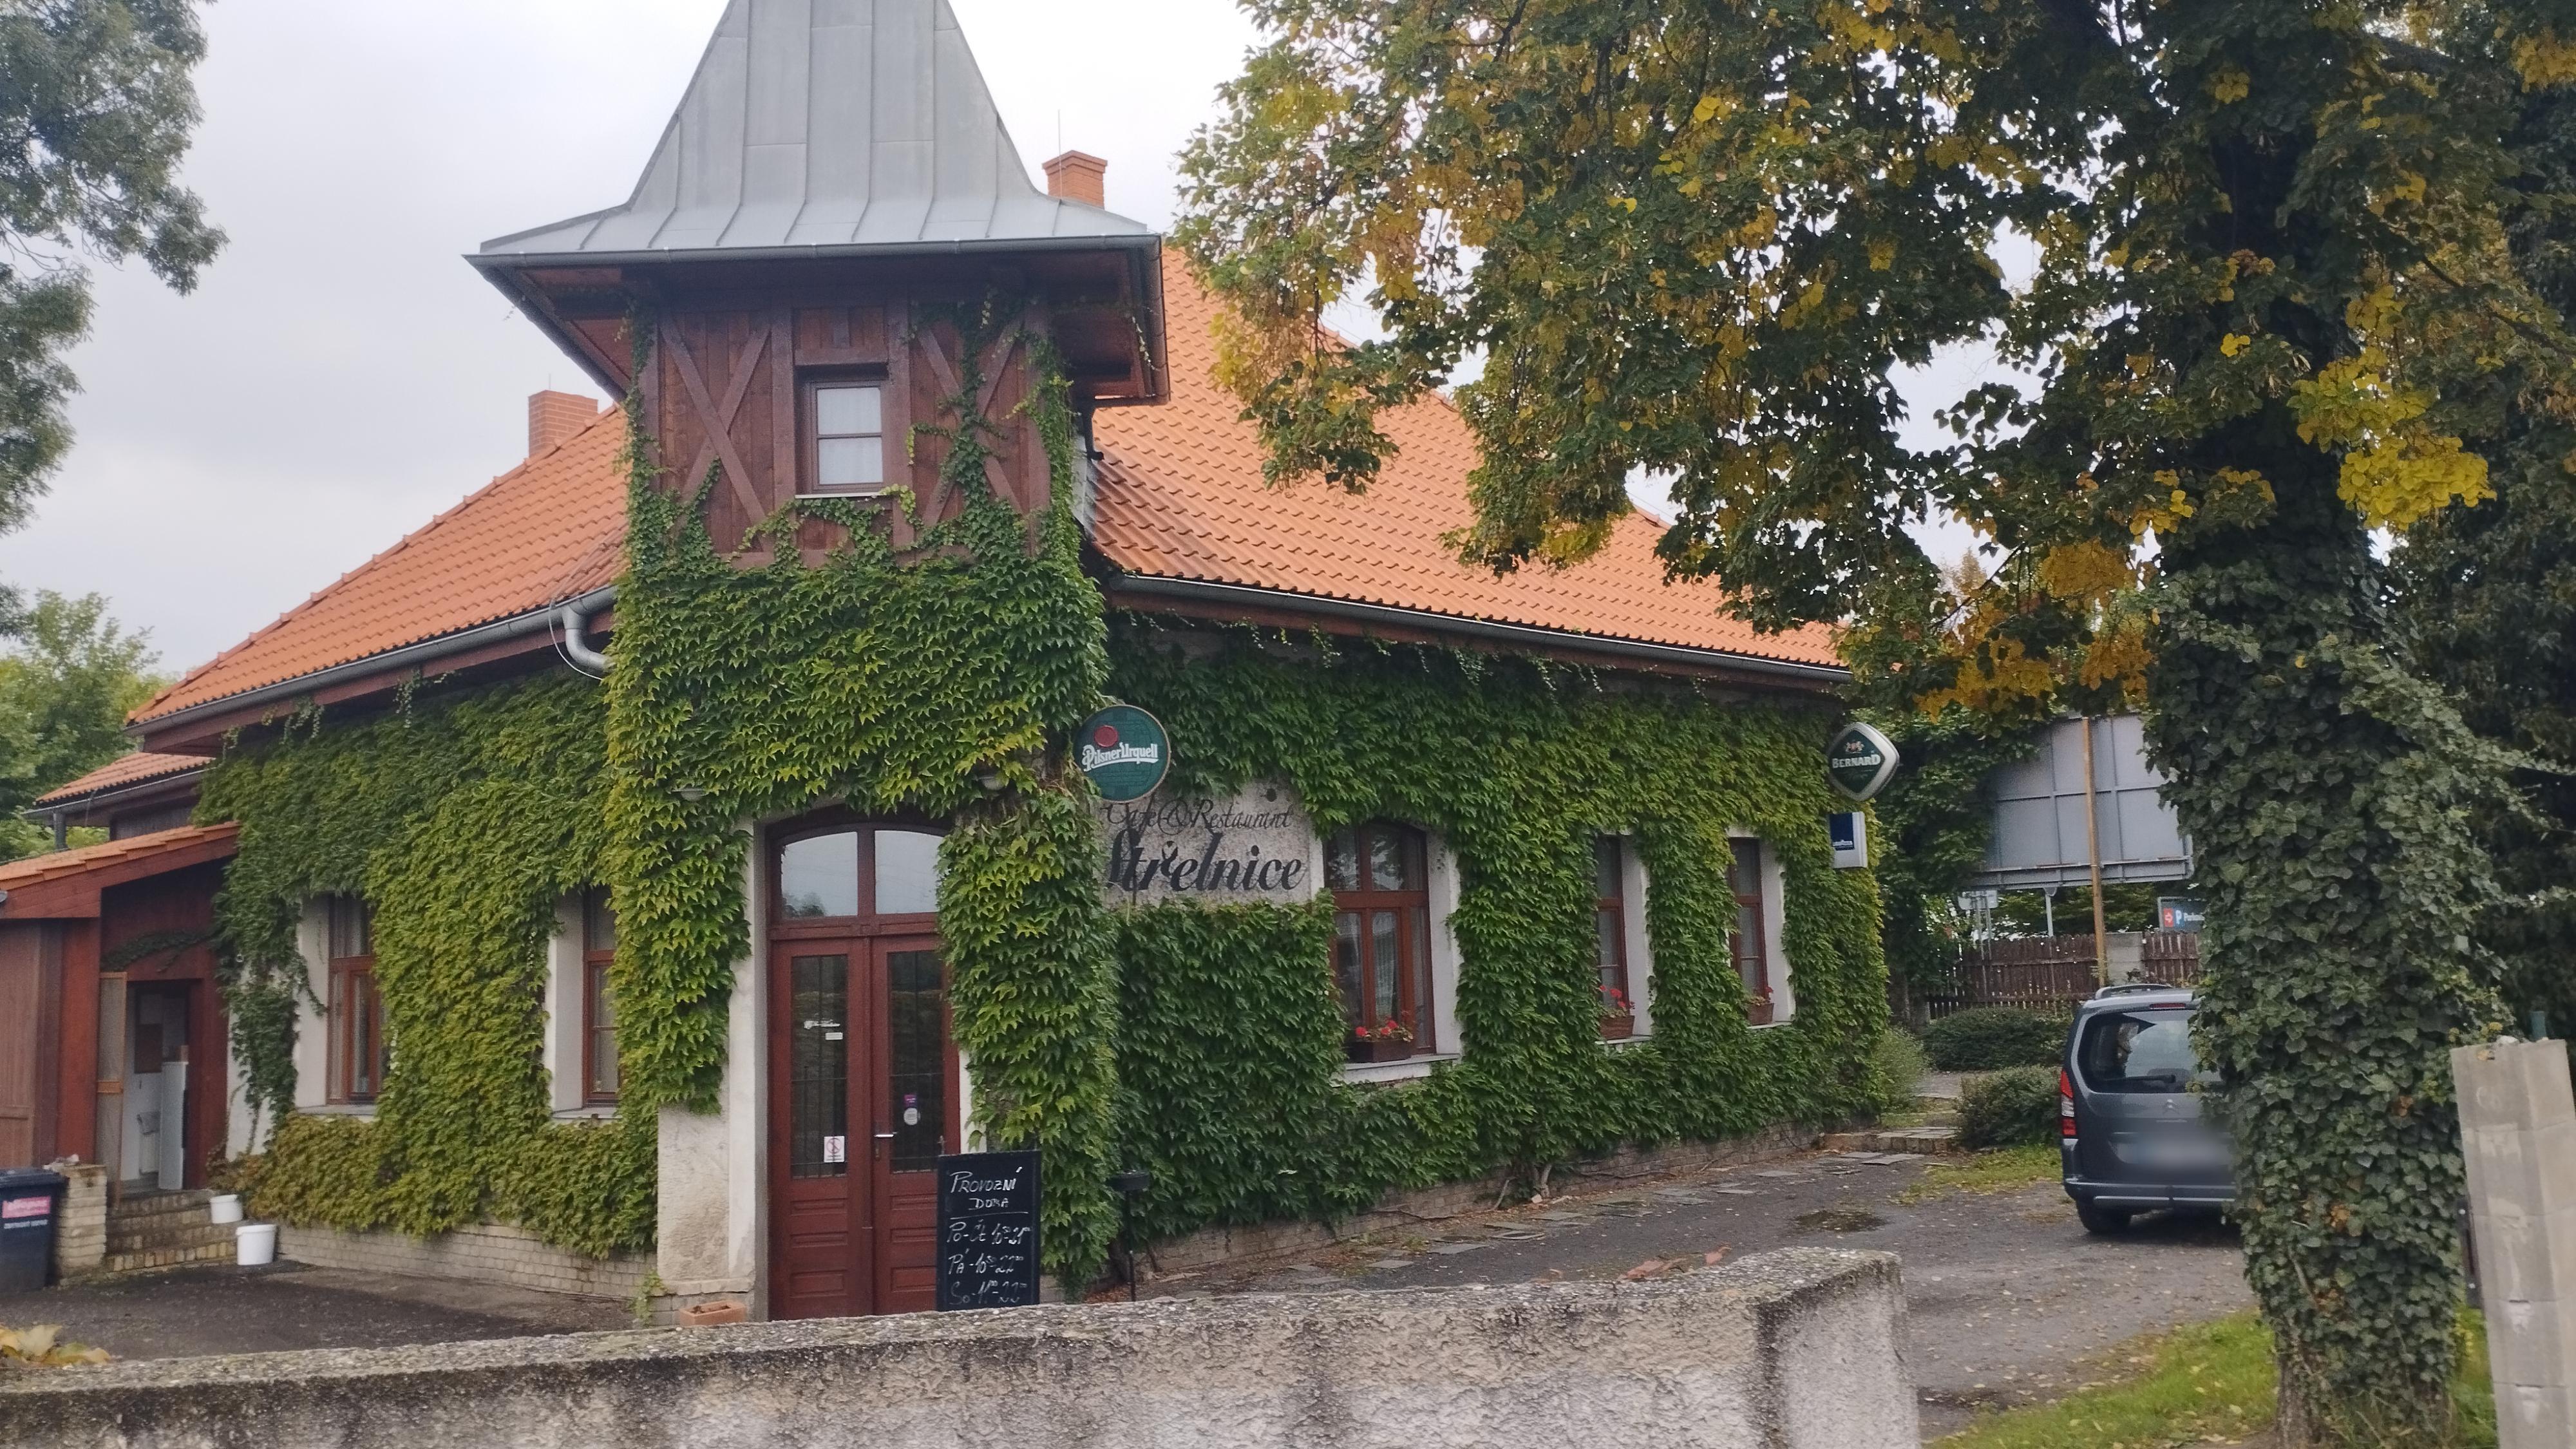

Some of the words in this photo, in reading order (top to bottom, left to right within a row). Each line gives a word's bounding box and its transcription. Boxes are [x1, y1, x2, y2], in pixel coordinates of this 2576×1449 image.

[1082, 744, 1121, 772] Pilsner
[1119, 742, 1158, 764] Urquell
[1832, 754, 1880, 768] BERNARD
[1191, 799, 1293, 829] Restaurant
[949, 1166, 1023, 1193] PROVOZNÍ
[969, 1198, 1009, 1210] DOBA
